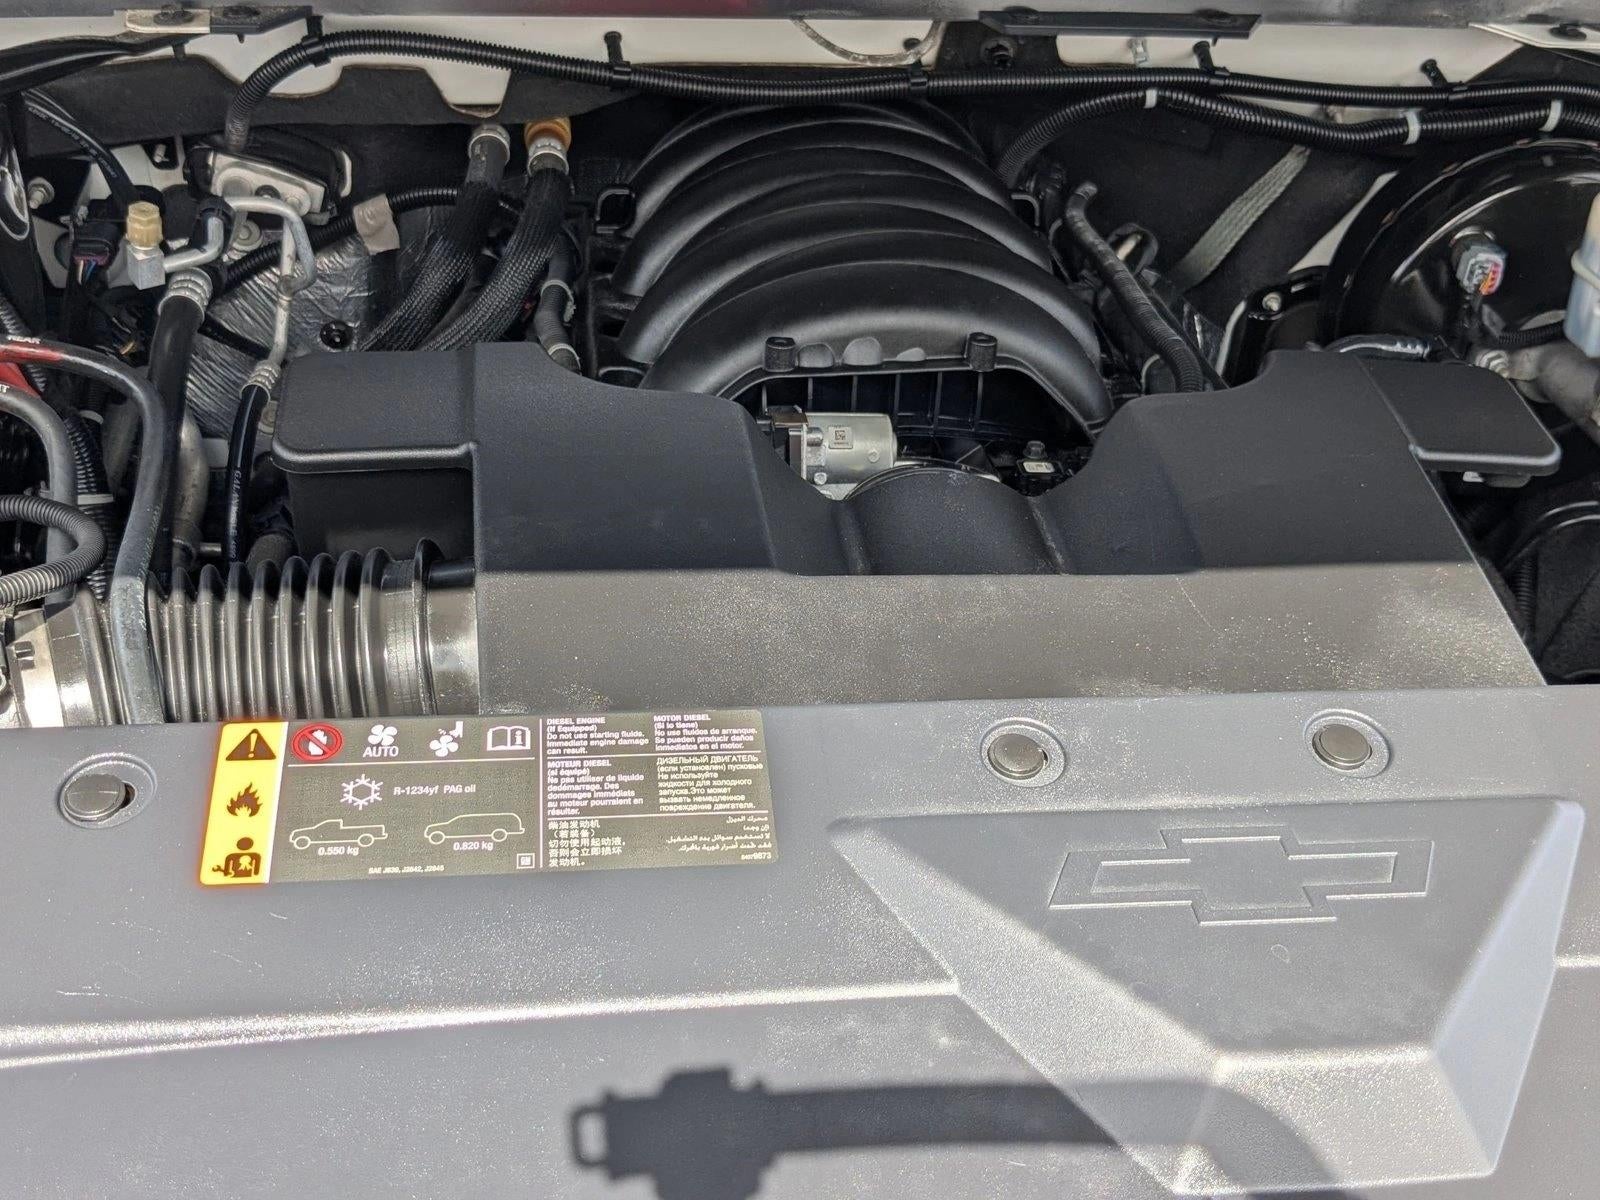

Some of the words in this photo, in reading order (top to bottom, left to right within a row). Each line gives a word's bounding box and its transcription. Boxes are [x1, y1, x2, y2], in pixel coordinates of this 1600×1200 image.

[547, 717, 575, 725] DIESEL
[590, 731, 619, 739] starting
[655, 729, 665, 737] No
[683, 728, 708, 736] fluidos
[590, 739, 616, 747] engine
[618, 738, 649, 746] damage
[667, 736, 696, 745] pueden
[697, 735, 729, 743] producir
[731, 734, 754, 742] daños
[363, 746, 399, 758] AUTO
[547, 760, 581, 768] MOTEUR
[583, 759, 611, 767] DIESEL
[656, 755, 709, 765] ДИЗЕЛЬНЫЙ
[710, 755, 759, 763] ДВИГАТЕЛЬ
[560, 777, 575, 785] pas
[618, 774, 644, 782] liquide
[393, 785, 439, 796] R-1234yf
[444, 785, 462, 793] PAG
[465, 784, 476, 793] oil
[604, 782, 619, 790] Des
[548, 791, 592, 800] dommages
[590, 798, 632, 807] pourraient
[453, 841, 480, 851] 0.820
[482, 841, 494, 851] kg
[347, 847, 359, 856] kg
